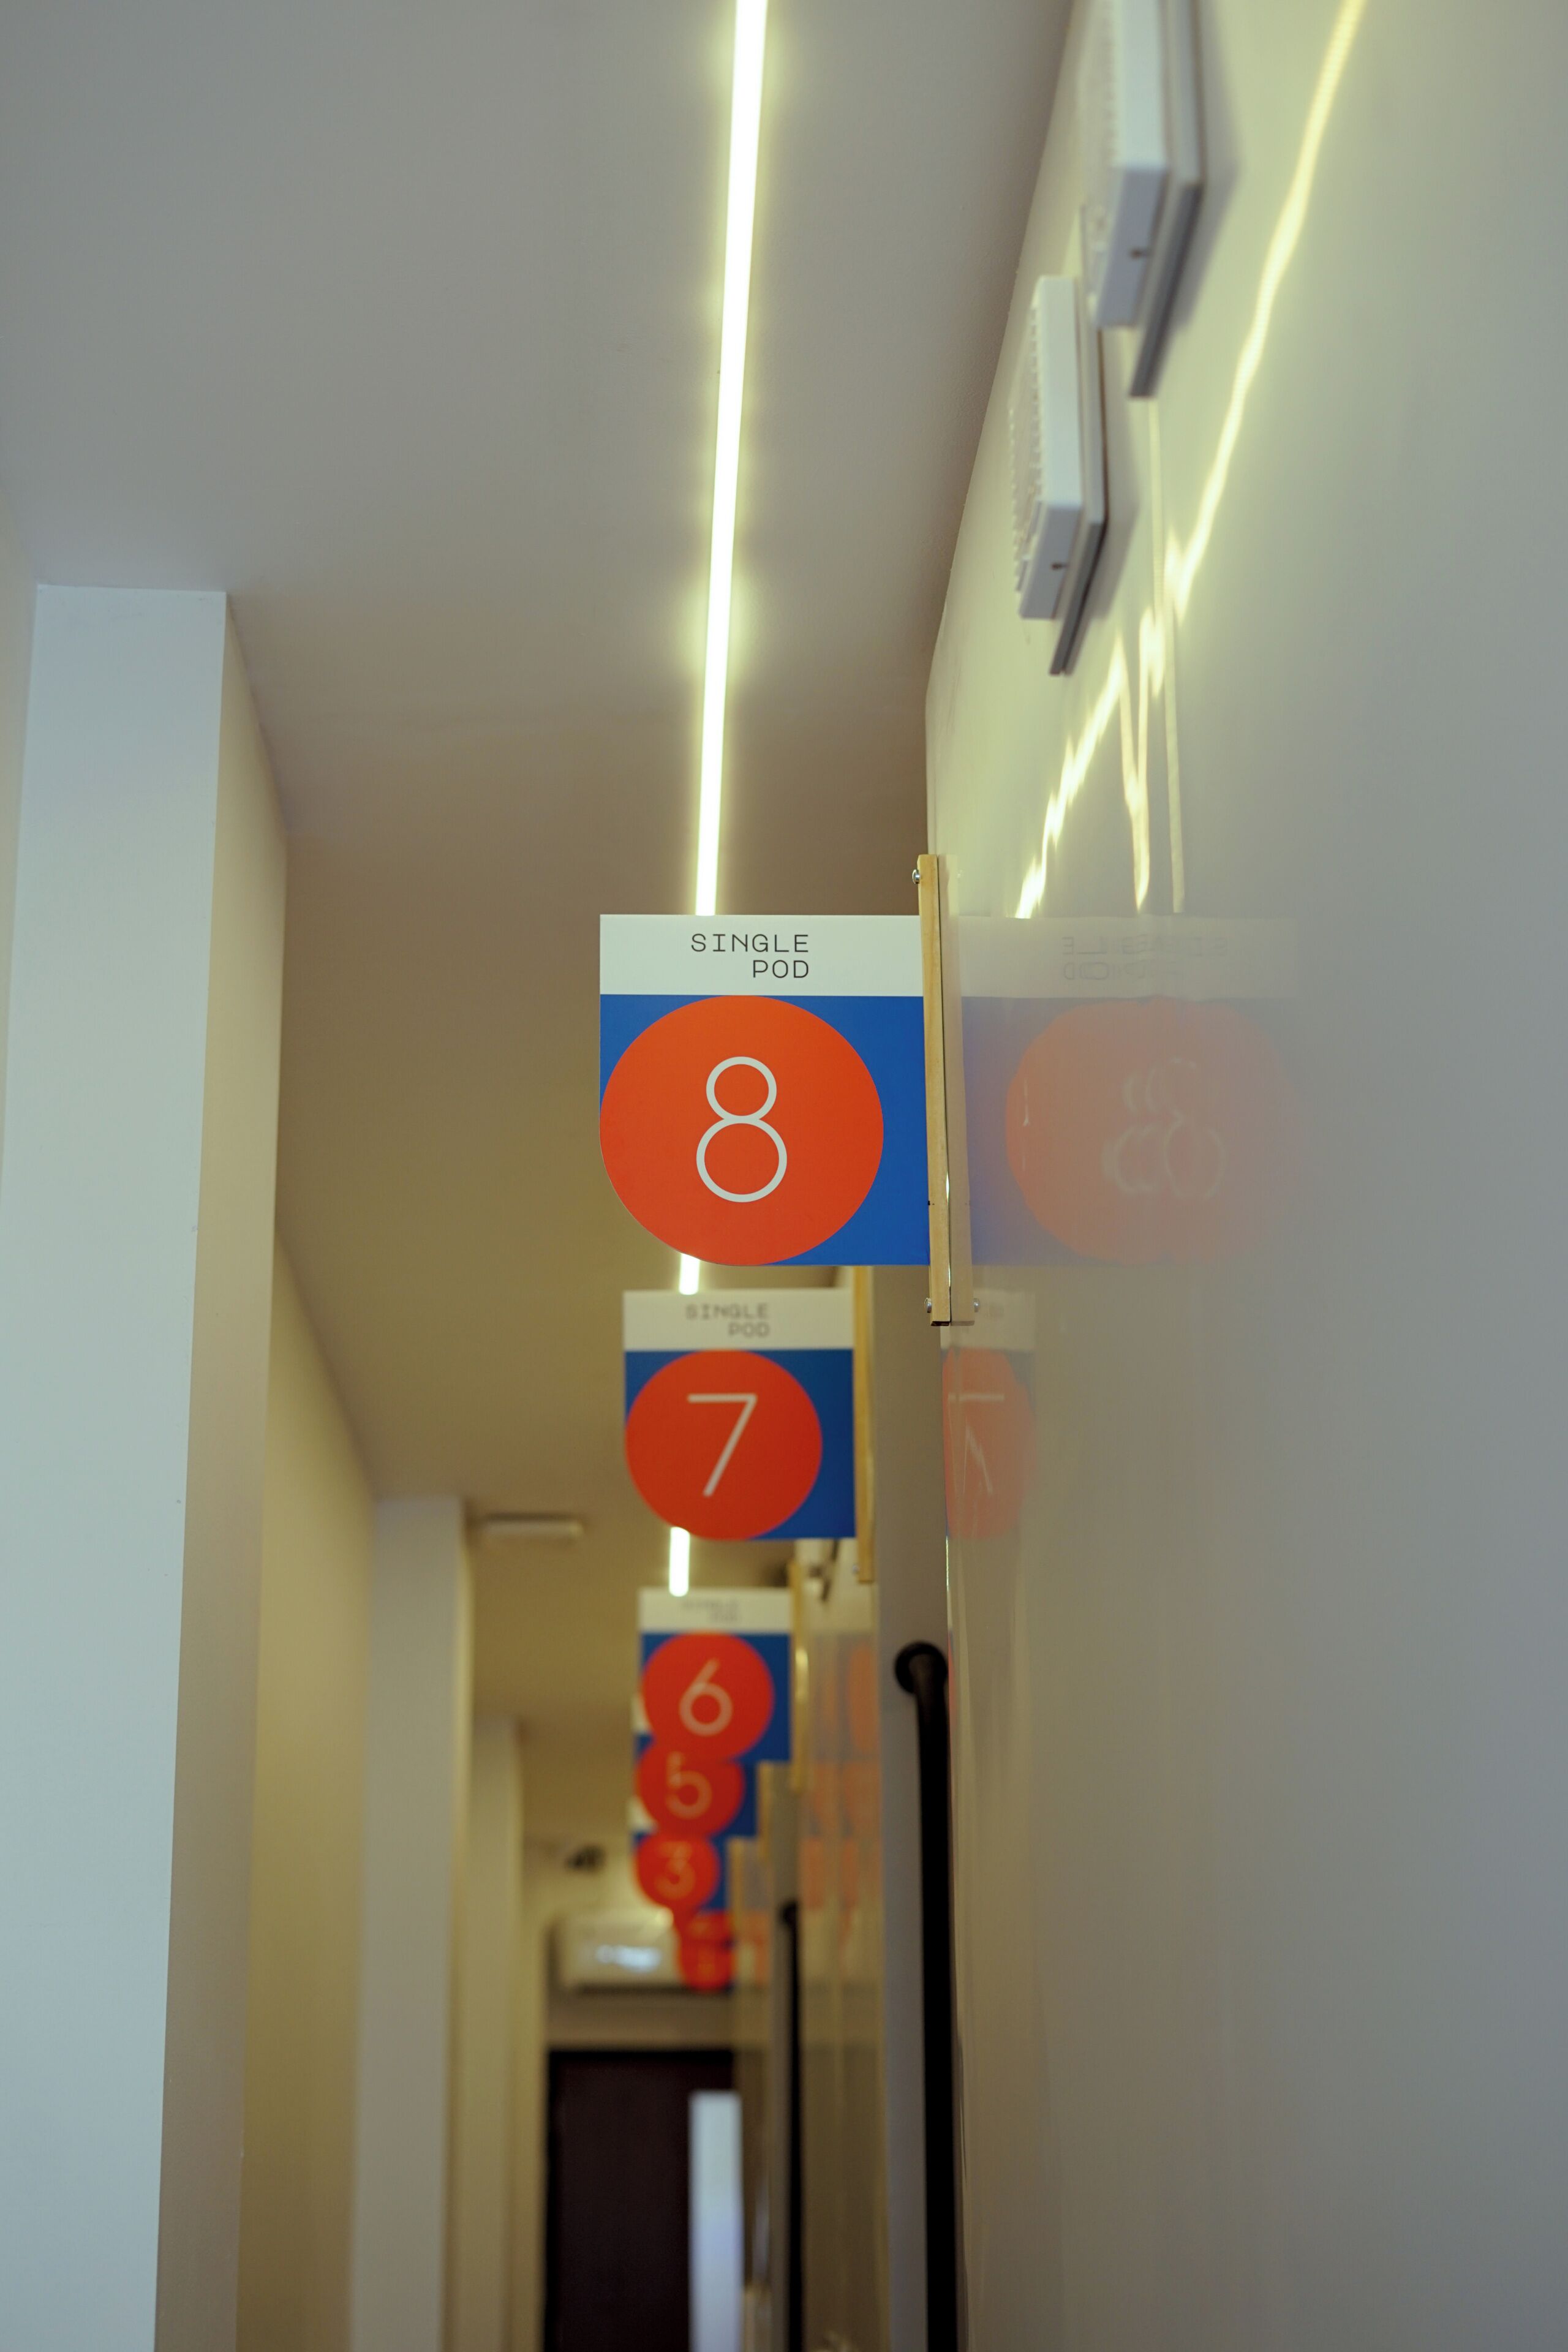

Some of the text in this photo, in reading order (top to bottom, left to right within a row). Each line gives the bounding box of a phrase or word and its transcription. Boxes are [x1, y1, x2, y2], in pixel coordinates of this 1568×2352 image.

[691, 933, 809, 952] SINGLE
[753, 960, 809, 978] POD
[696, 1056, 787, 1202] 8
[685, 1303, 769, 1320] SINGLE
[728, 1322, 771, 1338] POD
[687, 1393, 757, 1497] 7
[679, 1657, 733, 1736] 6
[665, 1751, 712, 1820] 5
[654, 1840, 696, 1901] 3
